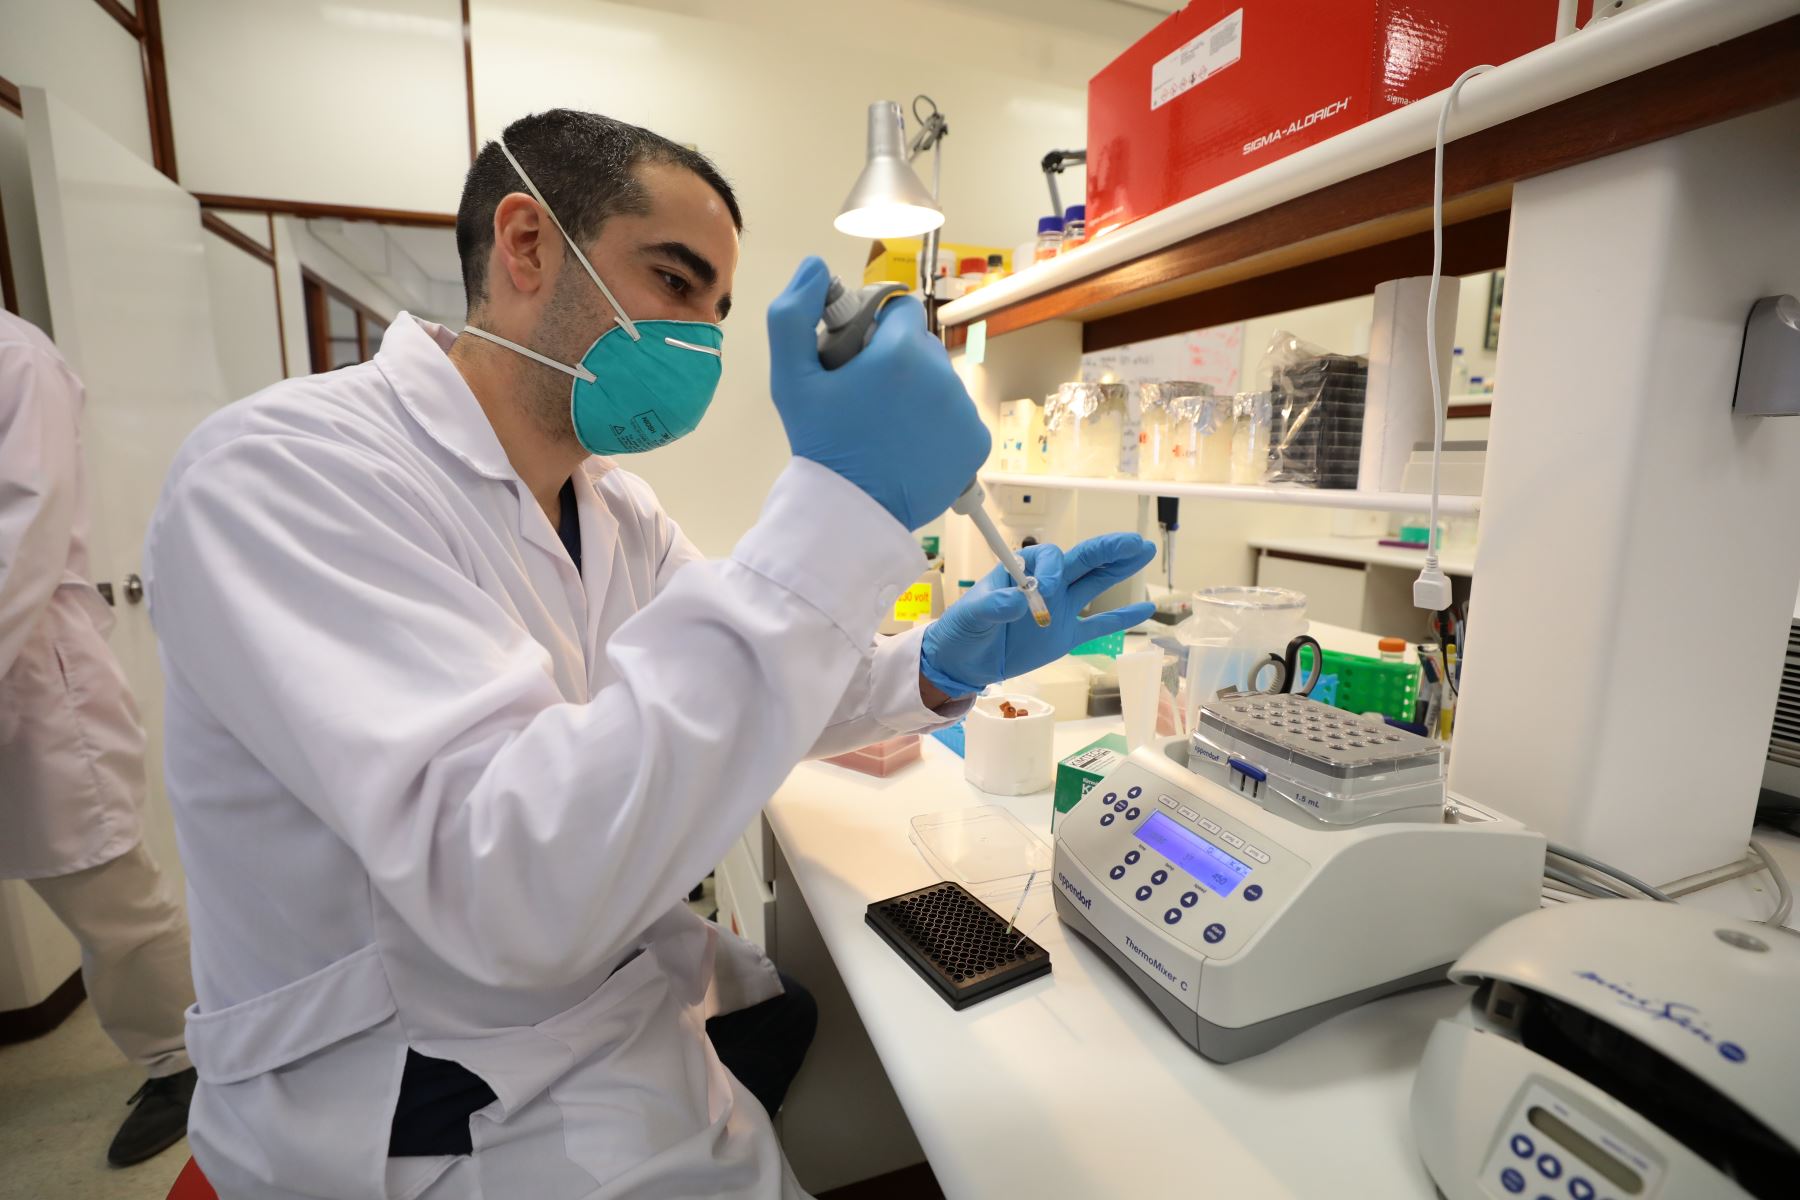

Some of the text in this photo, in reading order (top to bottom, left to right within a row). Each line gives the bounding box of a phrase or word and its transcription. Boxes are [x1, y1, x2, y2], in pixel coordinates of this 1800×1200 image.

[642, 416, 657, 433] NIOSH
[914, 591, 929, 602] volt
[1194, 745, 1220, 762] eppendorf
[1295, 793, 1320, 808] 1.5 mL
[1058, 872, 1092, 910] eppendorf
[1125, 936, 1188, 991] ThermoMixer C
